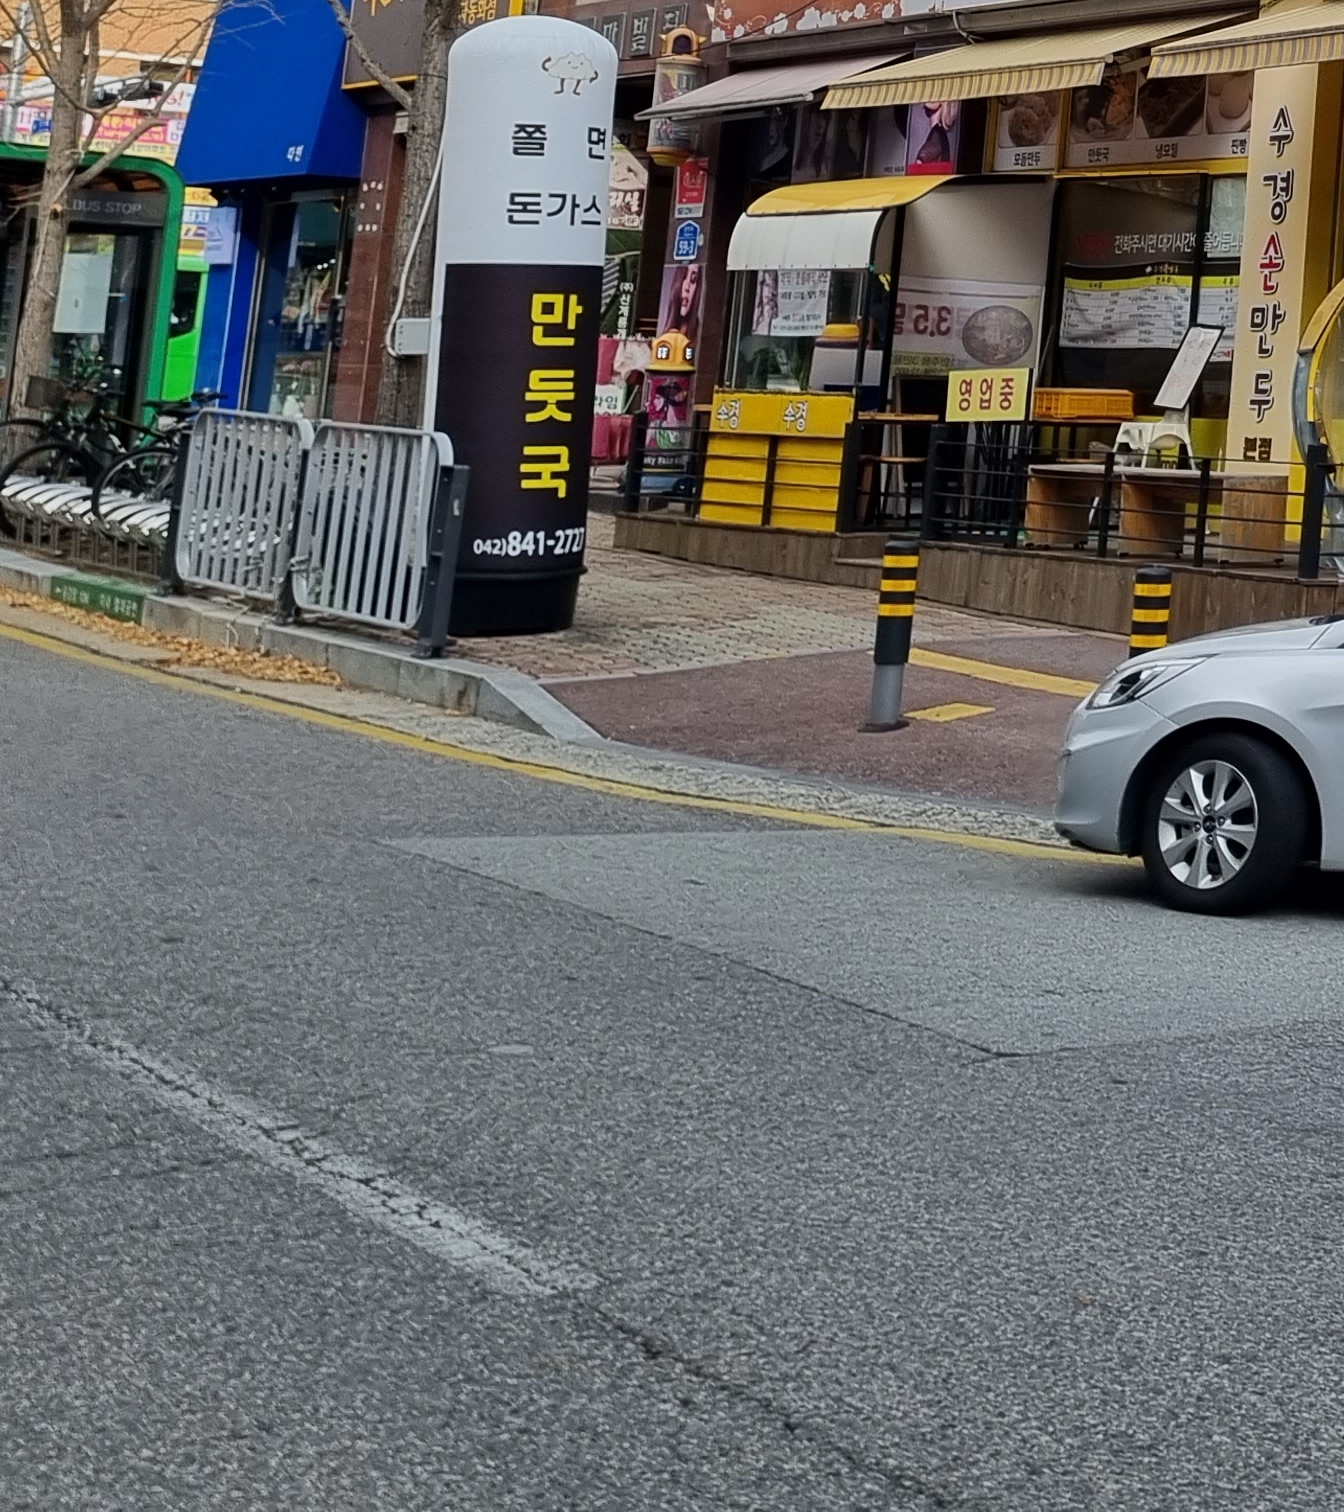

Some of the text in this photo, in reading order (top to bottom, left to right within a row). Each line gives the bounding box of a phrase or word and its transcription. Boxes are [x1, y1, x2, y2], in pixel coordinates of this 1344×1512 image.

[511, 123, 607, 160] 쫄면
[72, 198, 143, 214] BUS STOP
[1249, 102, 1296, 426] 수경손만두
[518, 291, 584, 499] 만둣국
[959, 377, 1014, 412] 영업중
[716, 398, 809, 432] 수경 수경
